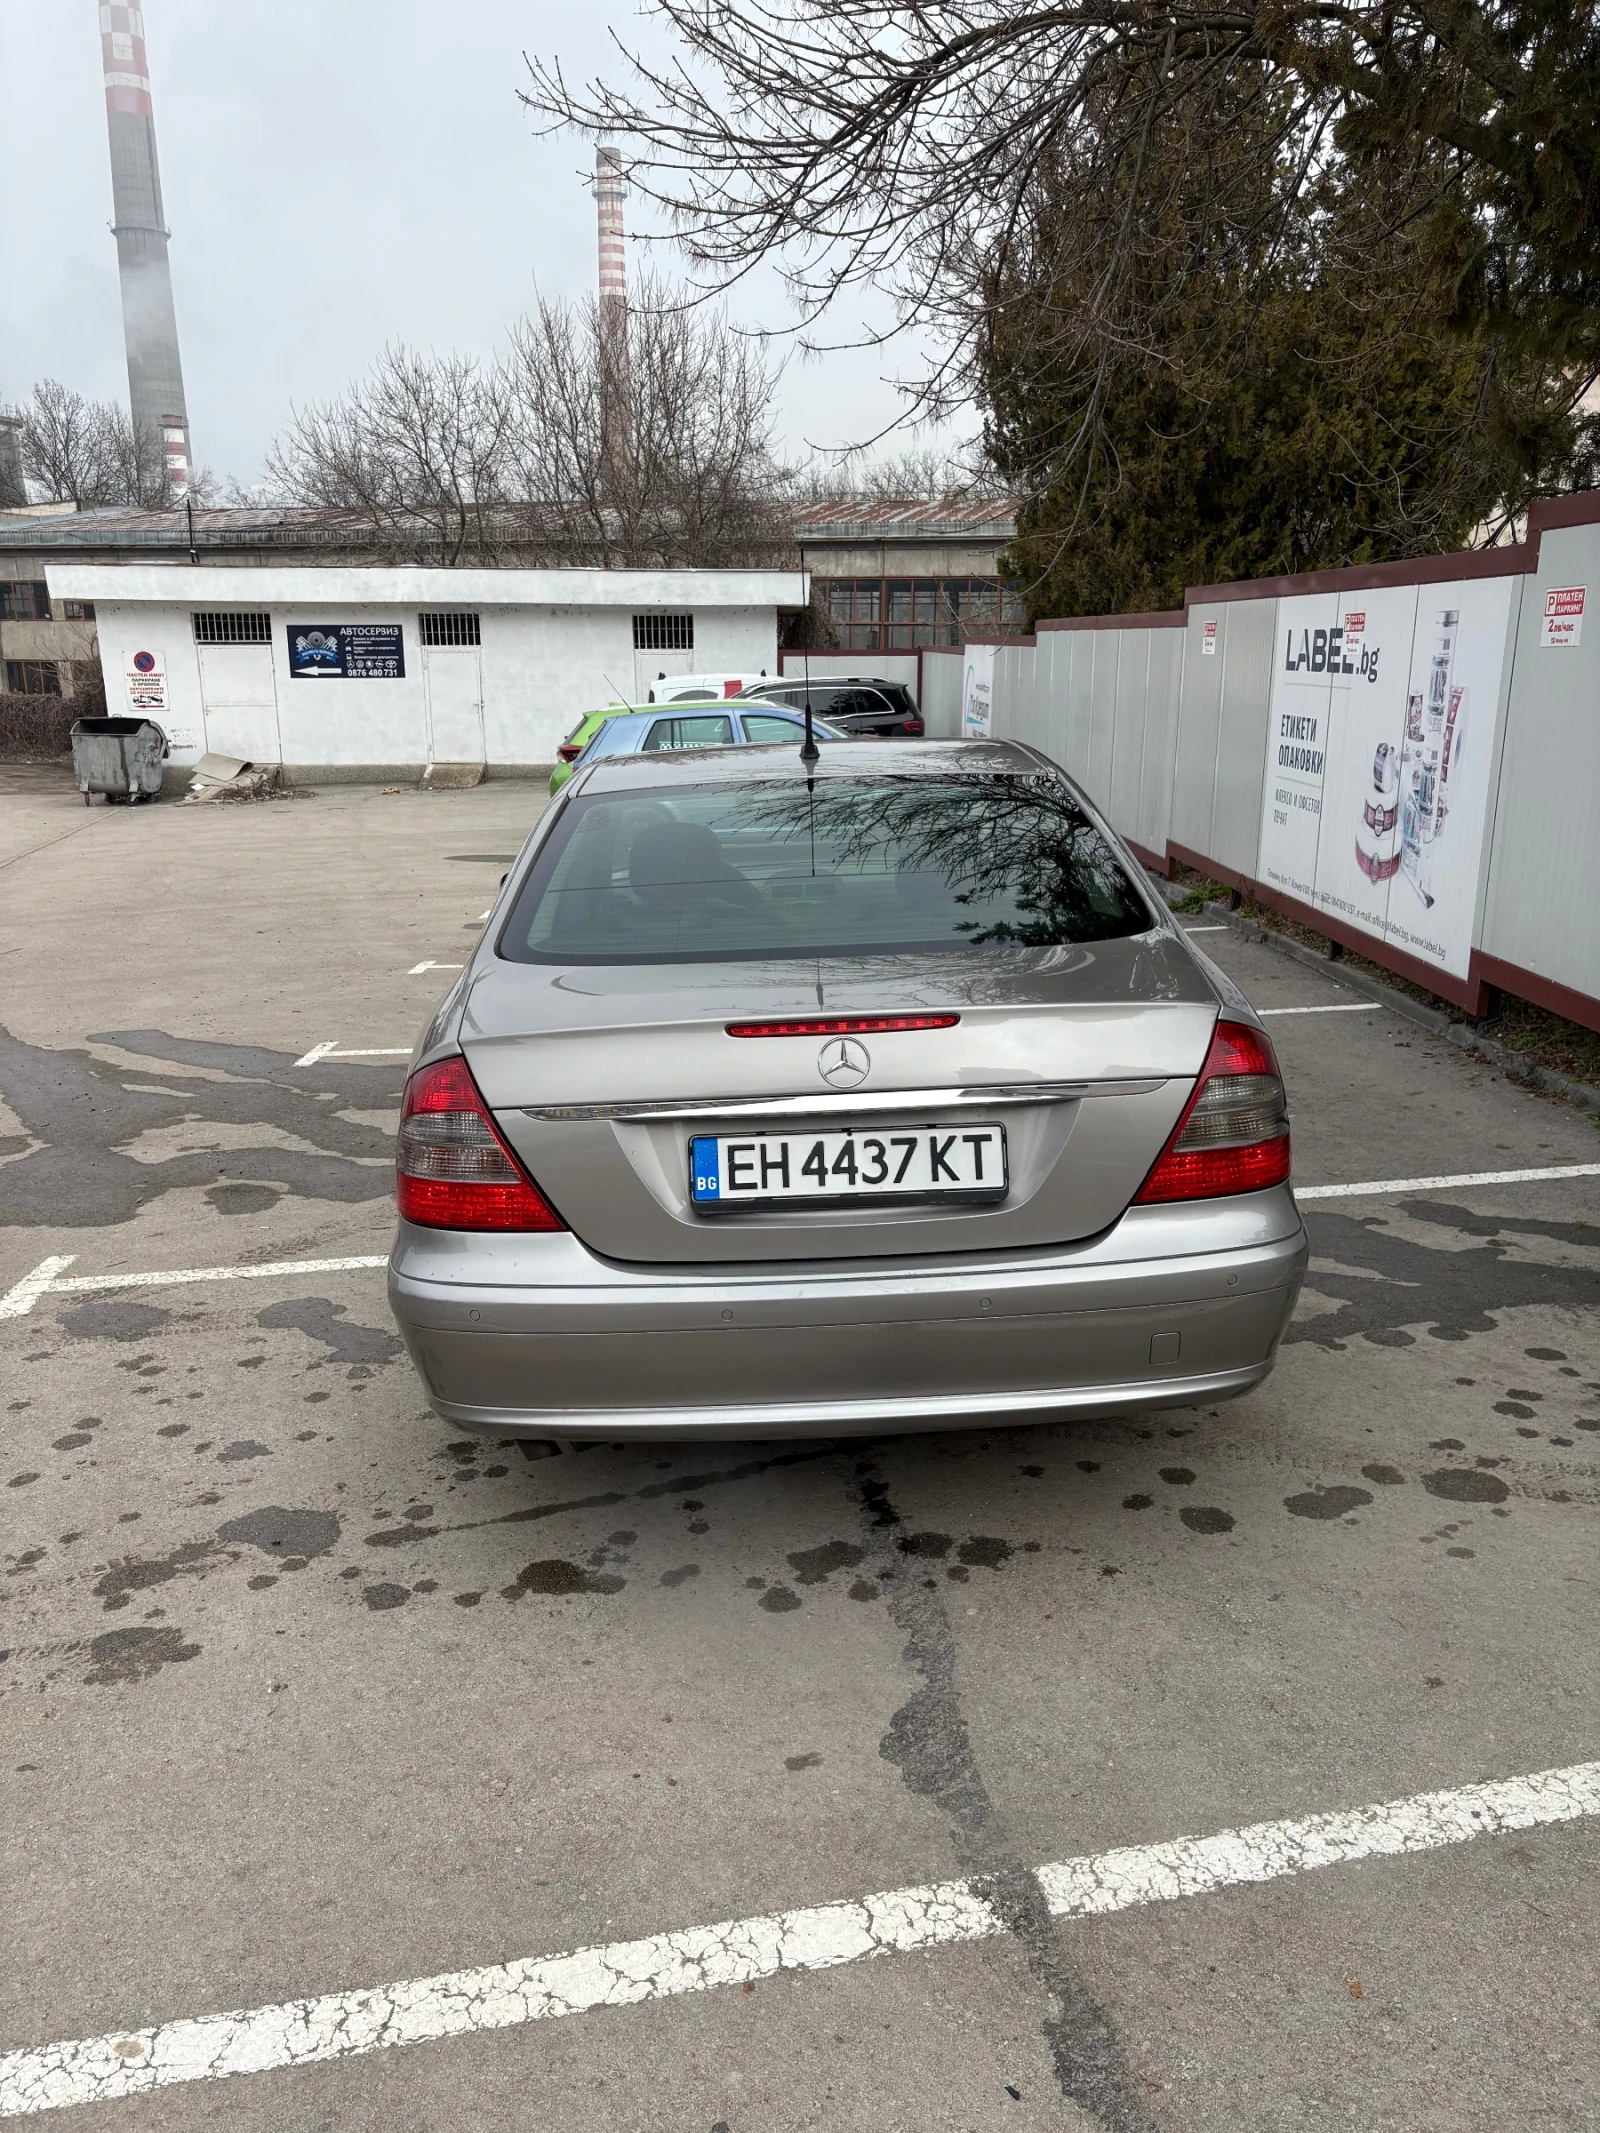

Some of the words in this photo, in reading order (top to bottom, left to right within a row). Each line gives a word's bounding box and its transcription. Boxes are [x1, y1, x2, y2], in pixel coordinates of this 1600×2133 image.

[1557, 591, 1583, 602] ПЛАТЕН
[1556, 603, 1582, 614] ПАРКИНГ
[340, 627, 399, 636] АВТОСЕРВИЗ
[1285, 628, 1380, 683] LABEL.bg
[347, 669, 367, 677] 0876
[368, 669, 383, 677] 480
[384, 669, 398, 677] 731
[1281, 714, 1317, 742] ЕТИКЕТИ
[1278, 744, 1323, 775] ОПАКОВКИ
[1273, 809, 1288, 826] ПЕЧАТ
[1410, 933, 1446, 961] www.label.bg
[727, 1142, 791, 1190] EH
[801, 1136, 918, 1187] 4437
[929, 1133, 993, 1182] KT
[697, 1177, 717, 1191] BG
